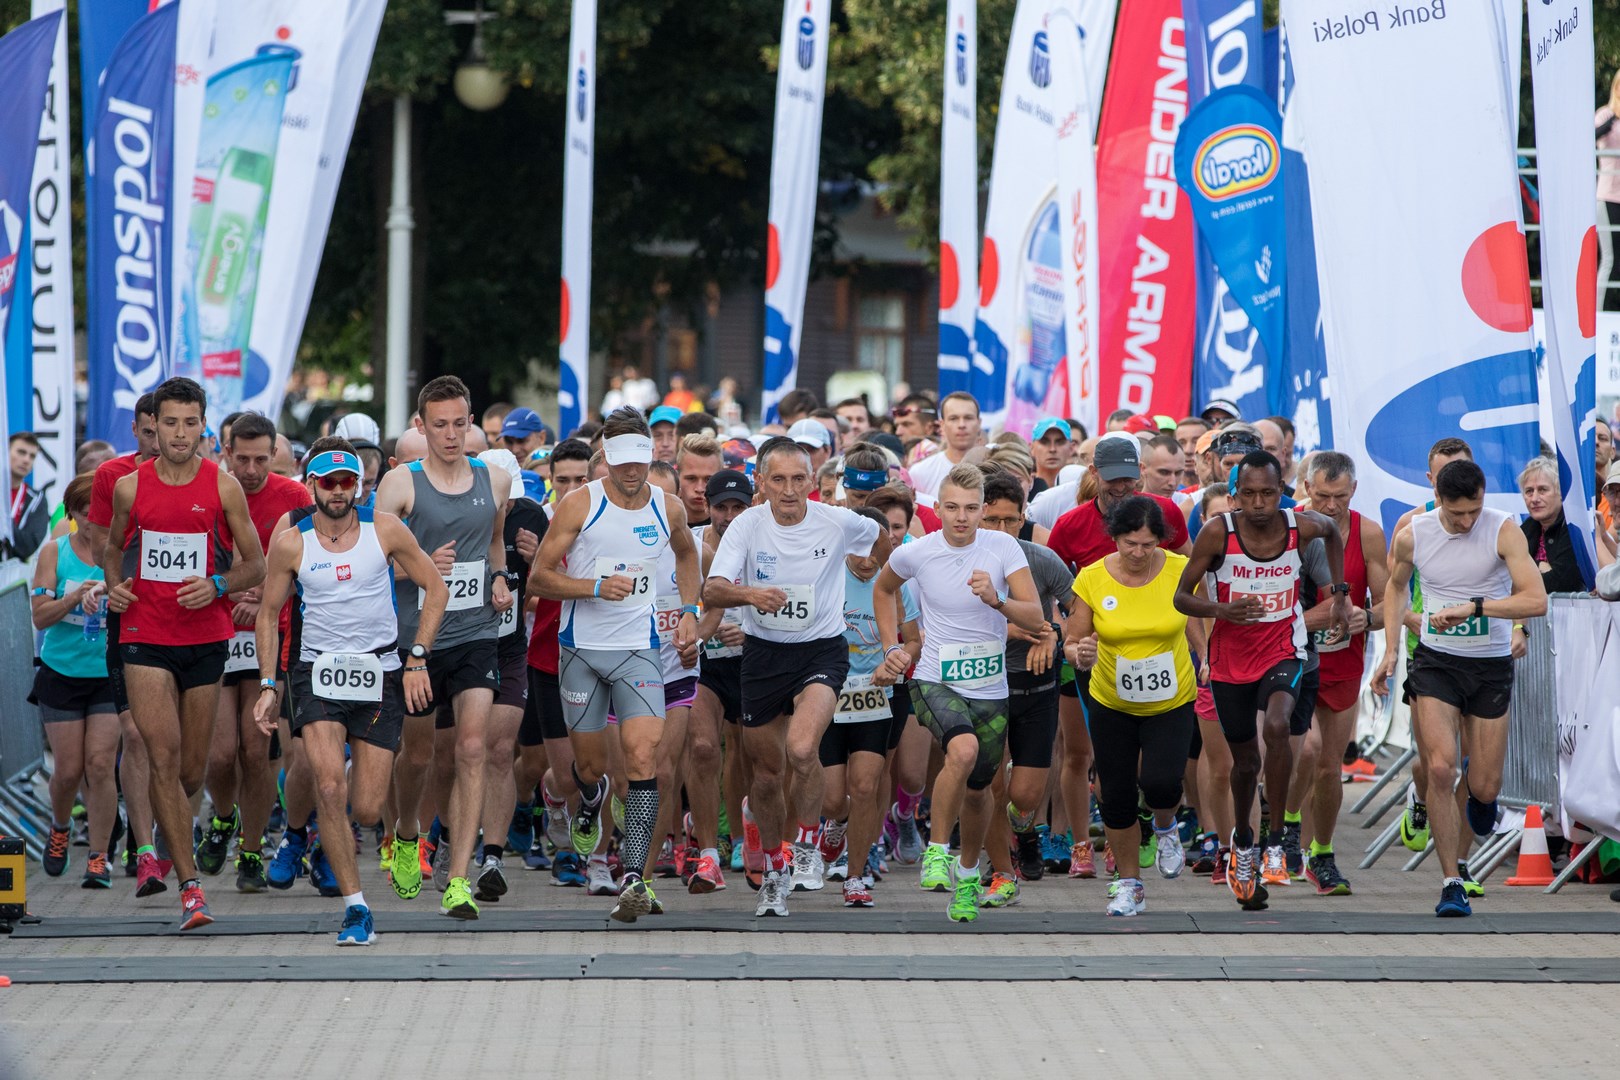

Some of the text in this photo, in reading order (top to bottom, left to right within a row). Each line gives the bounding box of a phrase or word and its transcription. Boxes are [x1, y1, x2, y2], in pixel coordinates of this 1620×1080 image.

[1117, 17, 1188, 416] UNDER ARMO
[108, 97, 165, 411] Konspol
[147, 549, 198, 570] 5041
[1233, 565, 1292, 579] Mr Price
[444, 578, 478, 598] 728
[319, 667, 376, 689] 6059
[946, 656, 999, 680] 4685
[1121, 669, 1171, 692] 6138
[839, 689, 886, 712] 2663
